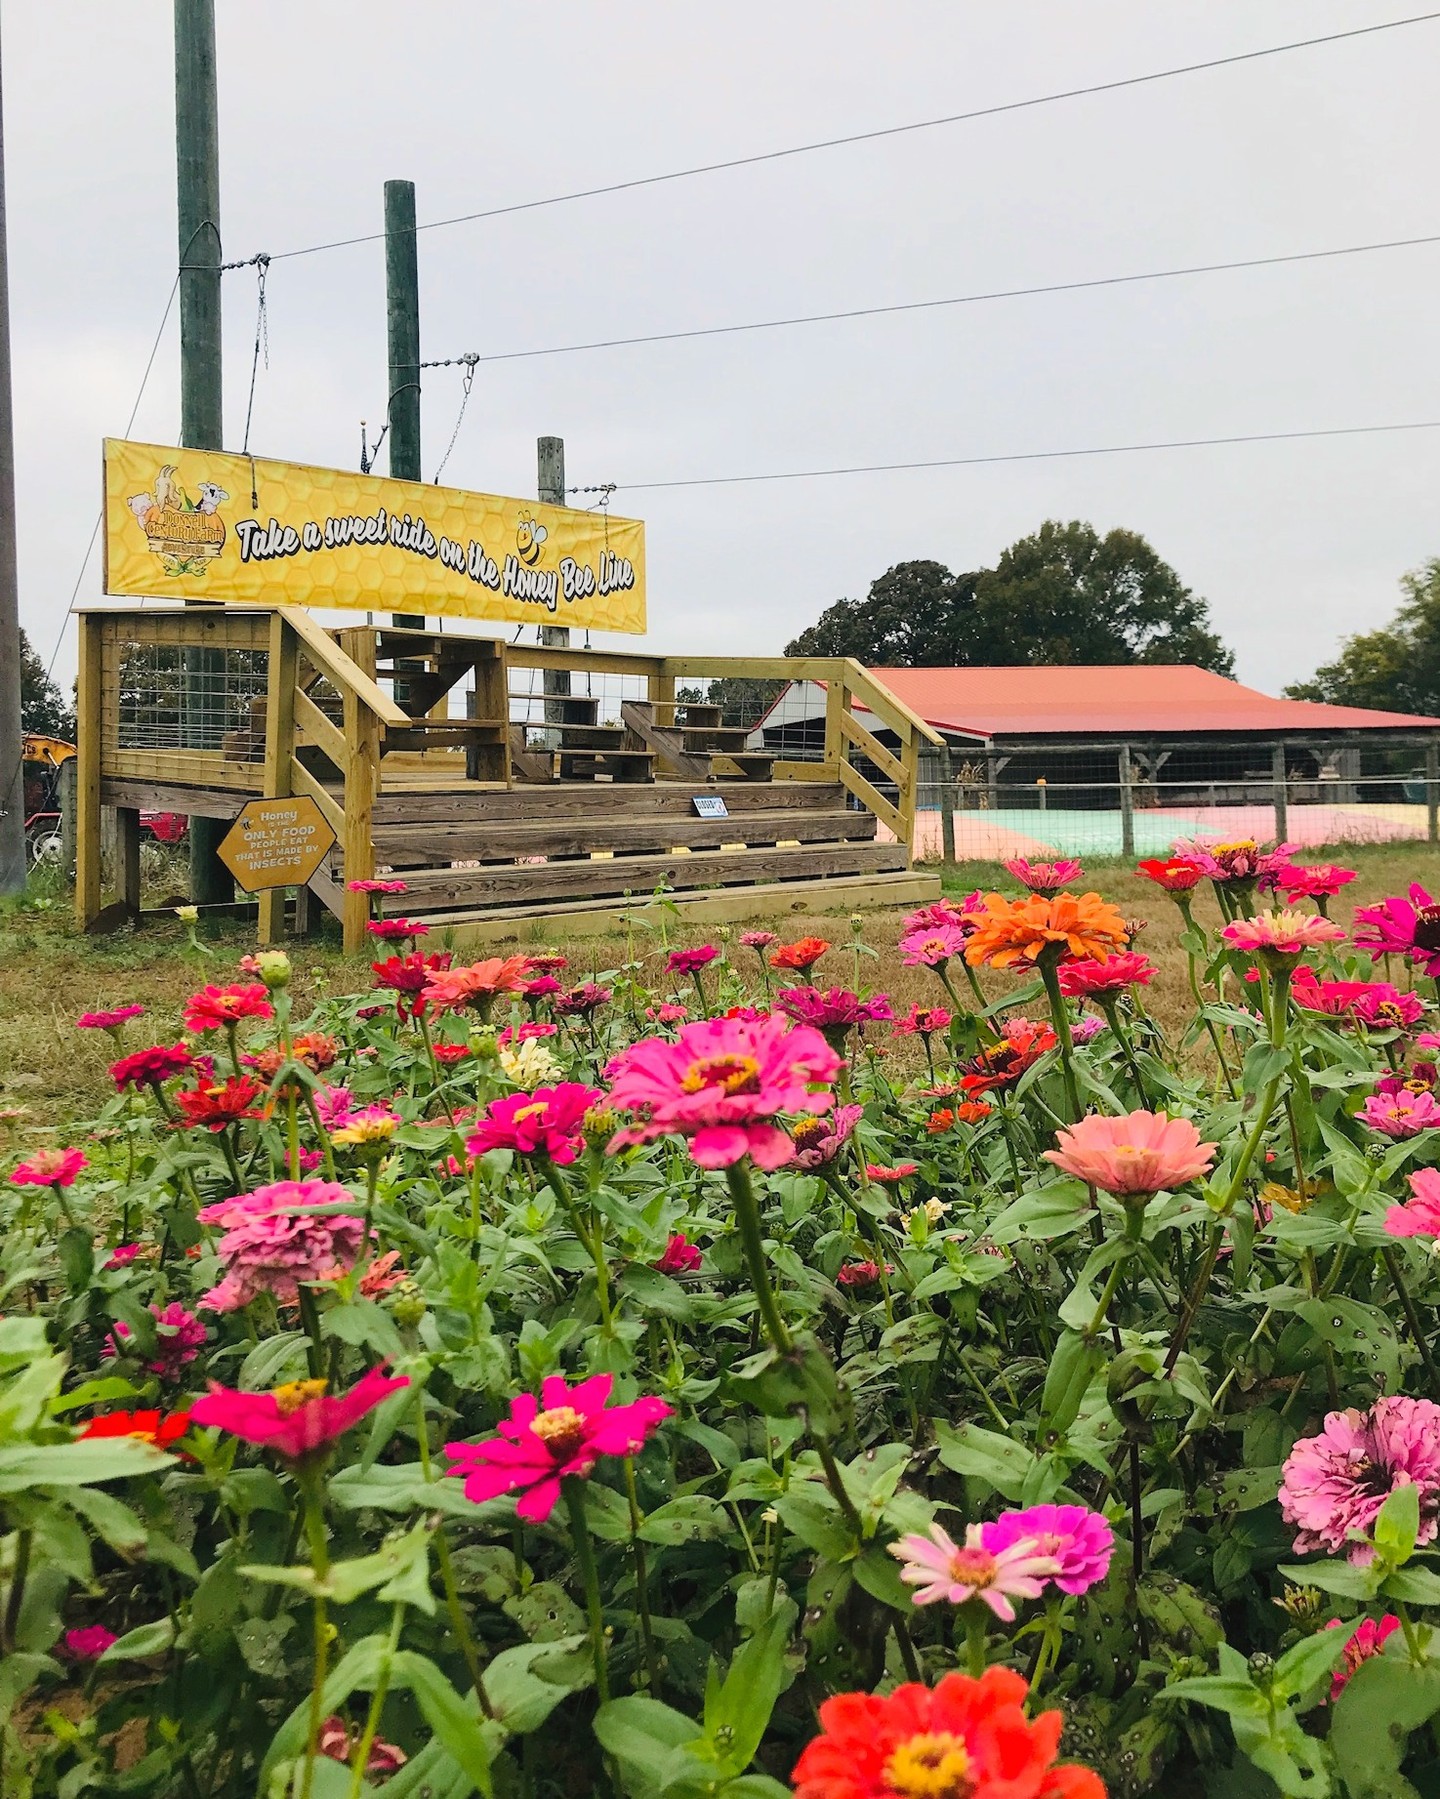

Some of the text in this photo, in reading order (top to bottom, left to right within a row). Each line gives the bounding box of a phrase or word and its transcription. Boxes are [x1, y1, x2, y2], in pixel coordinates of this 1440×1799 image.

[235, 507, 635, 612] Take a sweet ride on the Honey Bee Line
[260, 811, 298, 822] Honey
[243, 825, 316, 841] ONLY FOOD
[250, 836, 308, 849] PEOPLE EAT
[235, 852, 260, 862] THAT
[276, 846, 302, 856] MADE
[306, 845, 319, 853] BY
[249, 856, 302, 870] INSECTS
